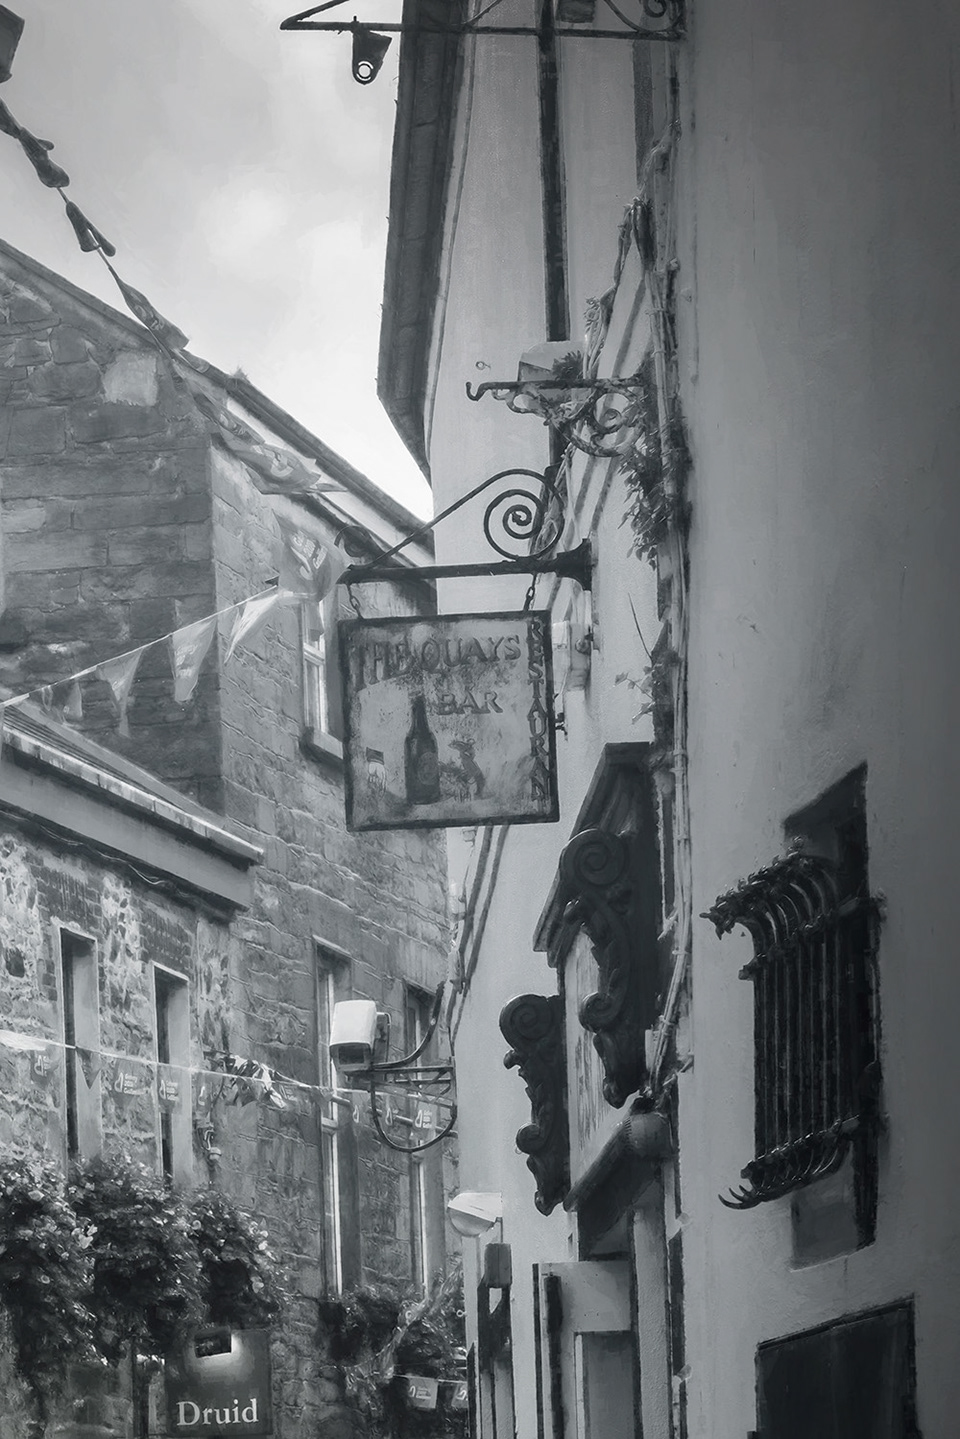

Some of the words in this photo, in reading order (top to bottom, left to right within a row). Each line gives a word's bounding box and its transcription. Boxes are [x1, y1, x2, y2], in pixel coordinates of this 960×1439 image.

[348, 635, 411, 691] THE
[419, 634, 521, 675] QUAYS
[436, 685, 504, 715] BAR
[176, 1398, 259, 1426] Druid
